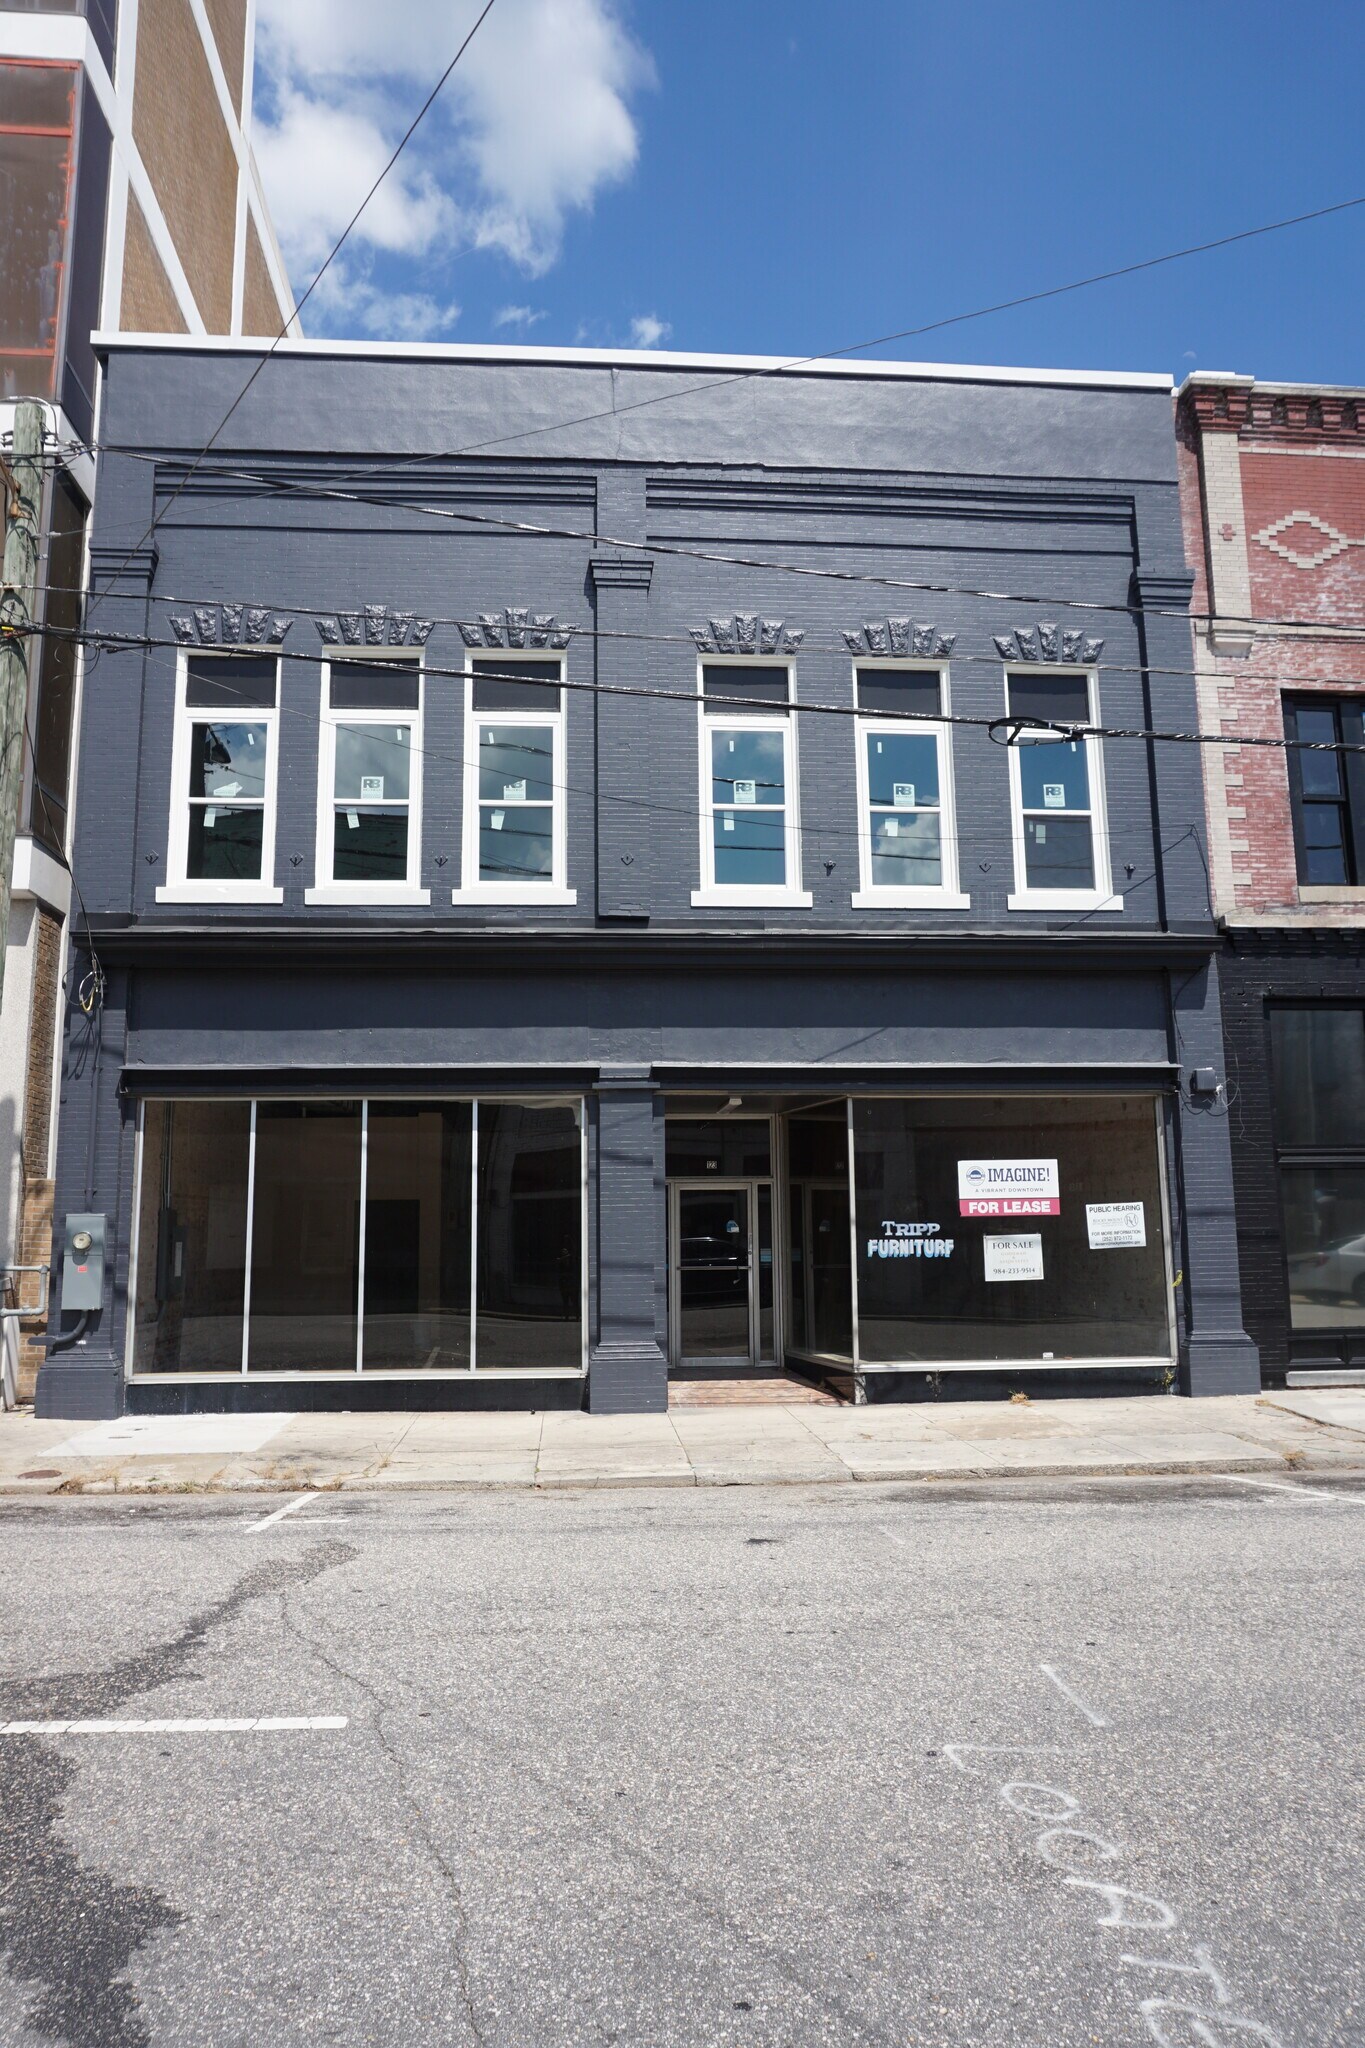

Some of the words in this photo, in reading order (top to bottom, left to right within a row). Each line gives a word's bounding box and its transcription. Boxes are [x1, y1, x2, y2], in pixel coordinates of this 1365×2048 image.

[988, 1167, 1050, 1182] IMAGINE!
[968, 1201, 999, 1214] FOR
[1003, 1200, 1051, 1213] LEASE
[881, 1221, 940, 1236] TRIPP
[1013, 1241, 1033, 1249] SALE
